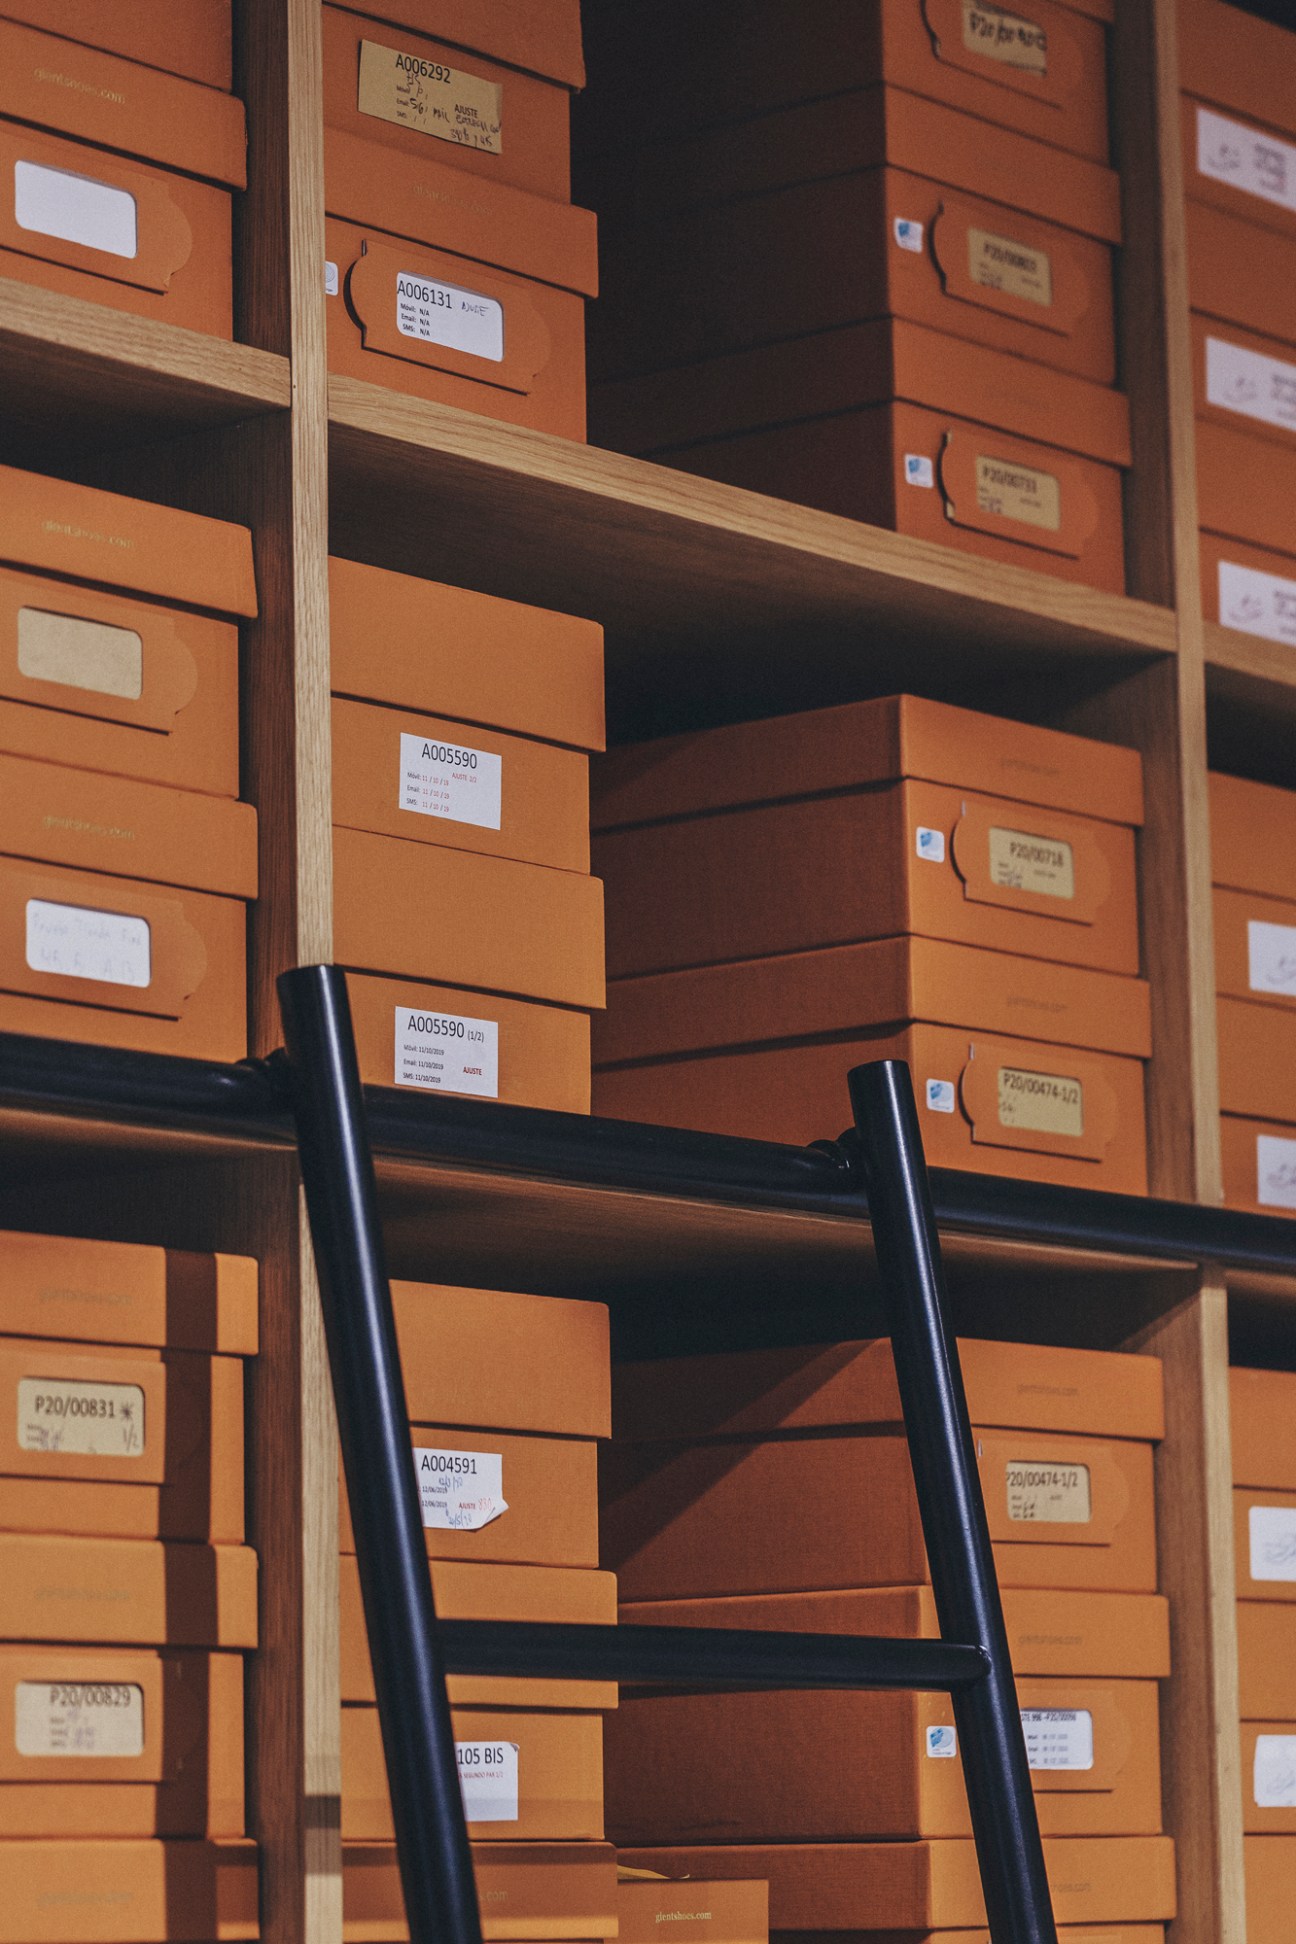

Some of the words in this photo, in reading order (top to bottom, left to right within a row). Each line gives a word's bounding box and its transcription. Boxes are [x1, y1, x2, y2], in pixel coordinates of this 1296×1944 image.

[395, 53, 451, 84] A006292
[454, 103, 478, 118] AJUSTE
[397, 280, 452, 309] A006131
[401, 313, 417, 323] Email:
[419, 318, 430, 327] N/A
[419, 308, 430, 316] N/A
[402, 323, 416, 333] SMS:
[420, 328, 430, 336] N/A
[421, 743, 477, 769] A005590
[408, 1015, 464, 1038] A005590
[467, 1029, 484, 1043] (1/2)
[463, 1066, 482, 1075] AJUSTE
[35, 1395, 115, 1419] P20/00831
[421, 1455, 477, 1474] A004591
[484, 1747, 504, 1764] BIS
